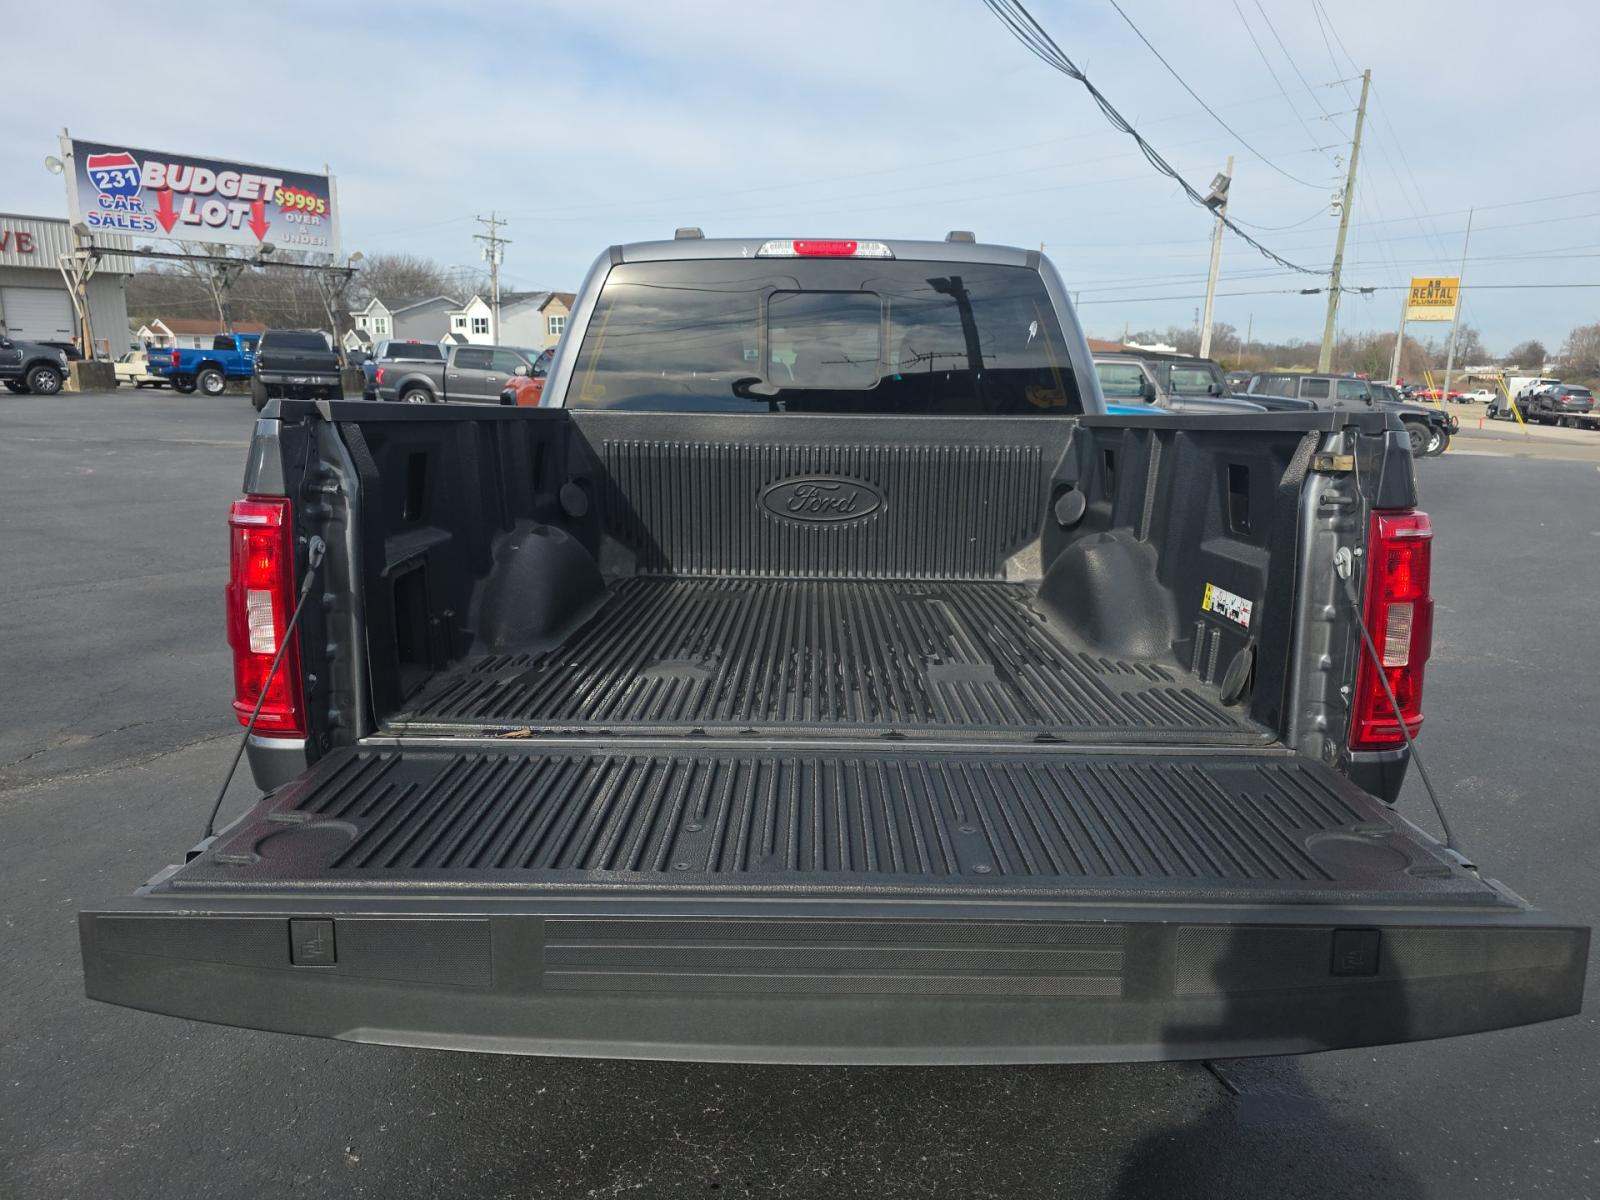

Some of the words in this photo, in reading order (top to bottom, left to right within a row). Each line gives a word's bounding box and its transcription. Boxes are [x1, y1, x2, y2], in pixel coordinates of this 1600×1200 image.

[96, 170, 138, 189] 231
[141, 160, 283, 202] BUDGET
[98, 194, 146, 213] CAR
[274, 187, 326, 214] $9995
[87, 211, 158, 233] SALES
[179, 199, 250, 230] LOT
[286, 212, 321, 226] OVER
[281, 232, 328, 247] UNDER
[1412, 288, 1453, 299] RENTAL
[787, 484, 858, 512] Ford
